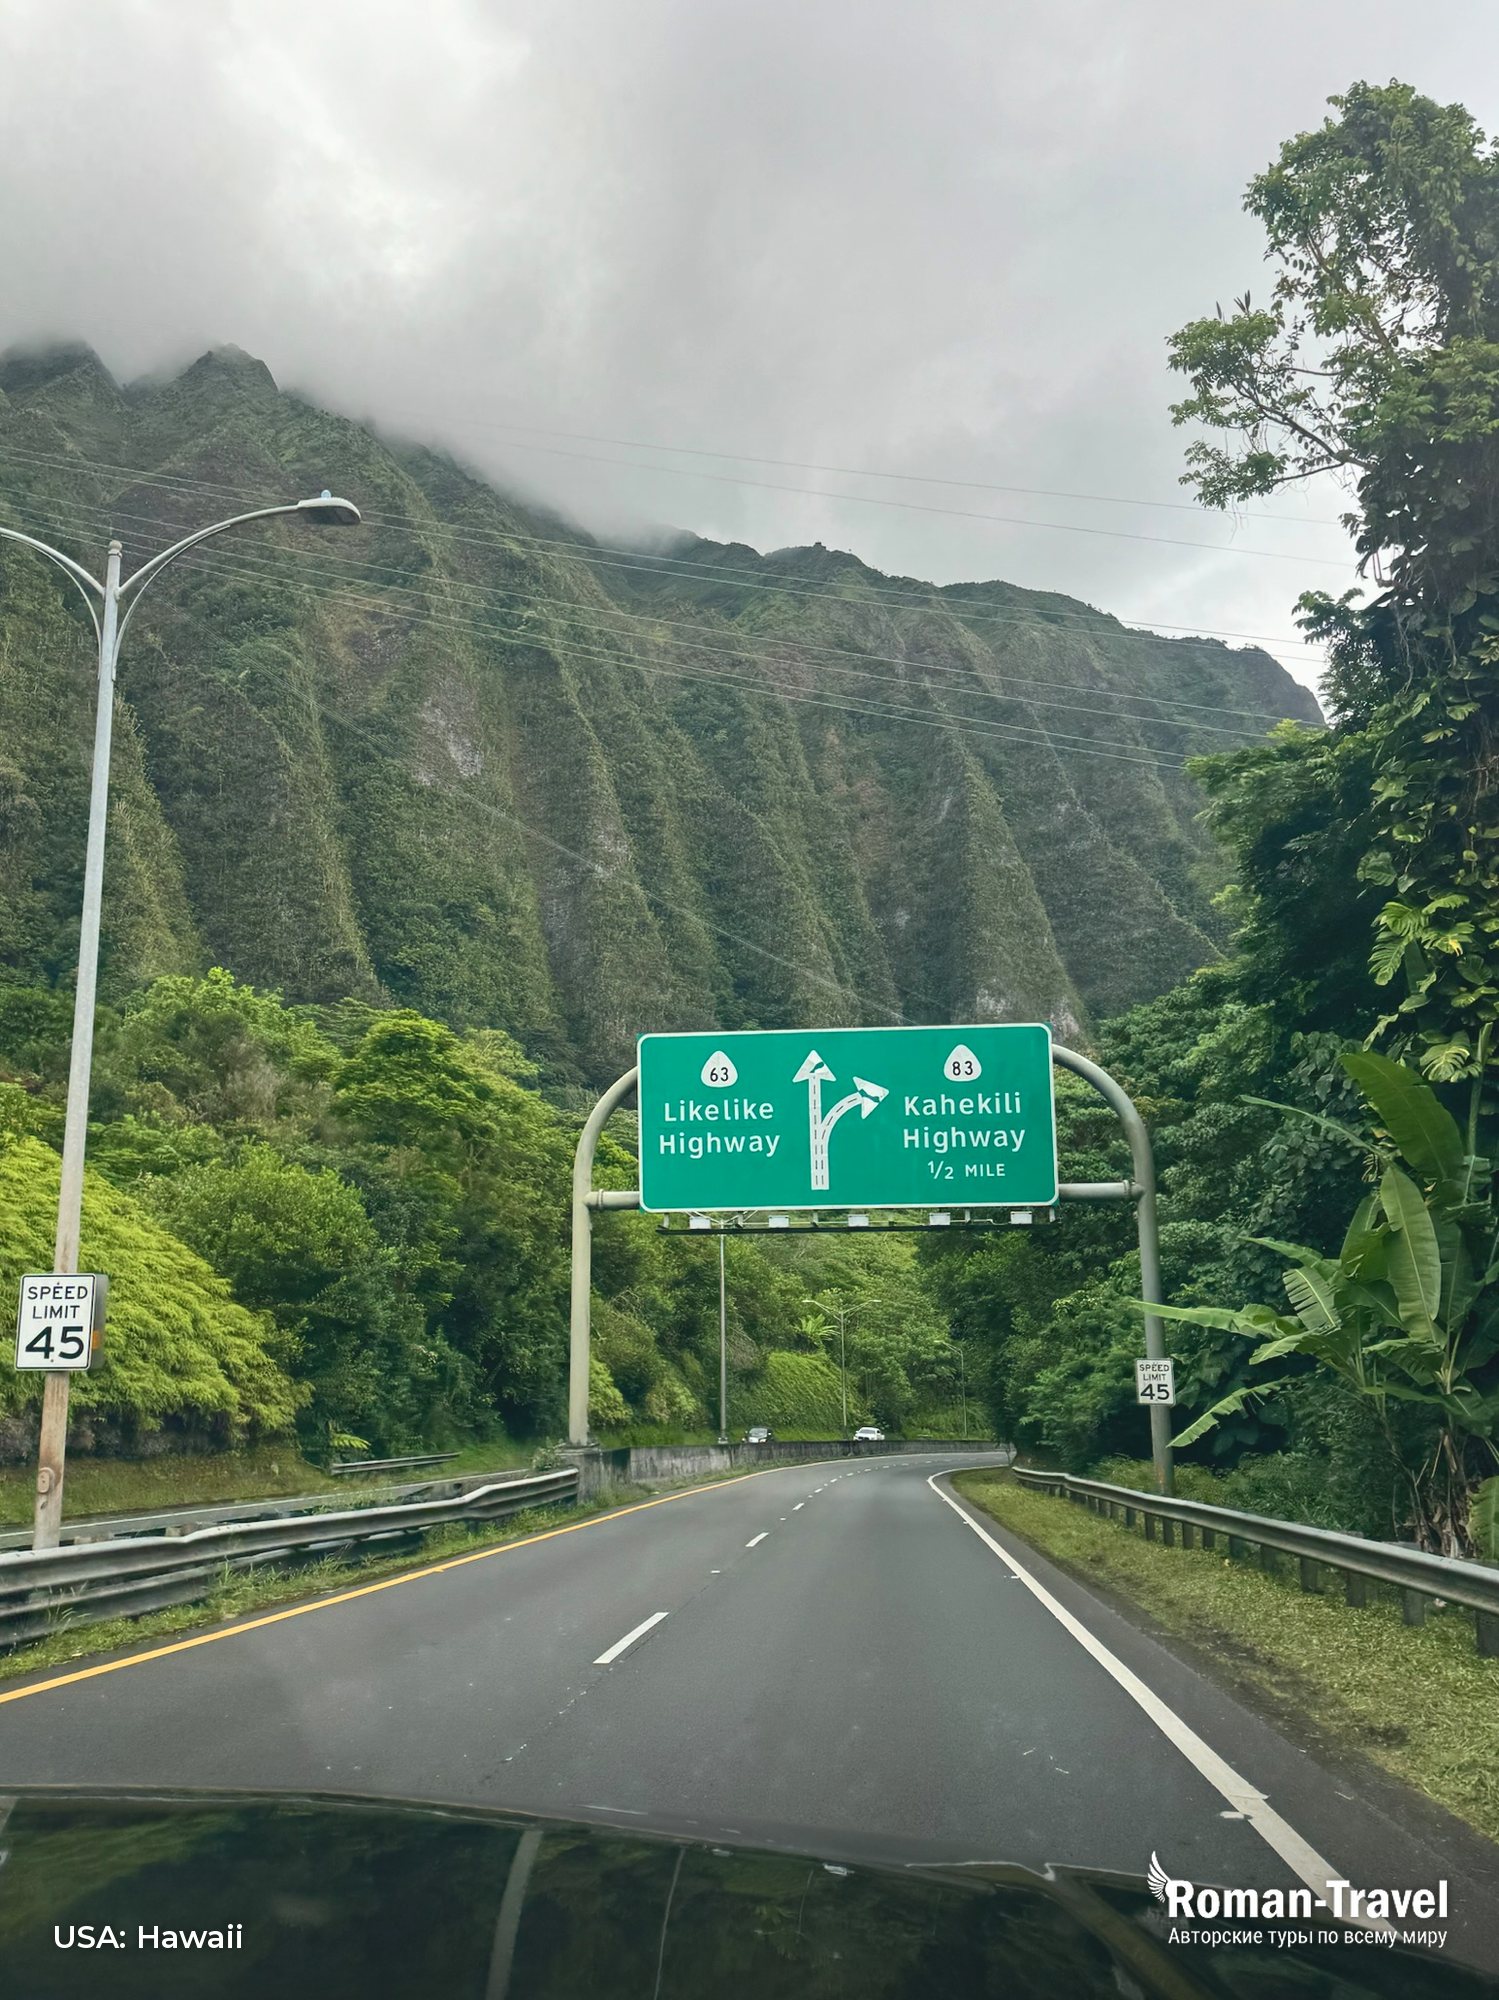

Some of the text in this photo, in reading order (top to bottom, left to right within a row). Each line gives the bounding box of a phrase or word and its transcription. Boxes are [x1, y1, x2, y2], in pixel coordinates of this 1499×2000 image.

[709, 1066, 729, 1083] 63
[951, 1060, 974, 1077] 83
[664, 1099, 775, 1122] Likelike
[904, 1092, 1022, 1116] Kahekili
[659, 1132, 780, 1158] Highway
[903, 1127, 1026, 1153] Highway
[928, 1160, 1006, 1180] 1/2 MILE
[27, 1286, 88, 1300] SPEED
[32, 1305, 80, 1319] LIMIT
[25, 1326, 85, 1360] 45
[1139, 1364, 1170, 1372] SPEED
[1140, 1384, 1170, 1400] 45
